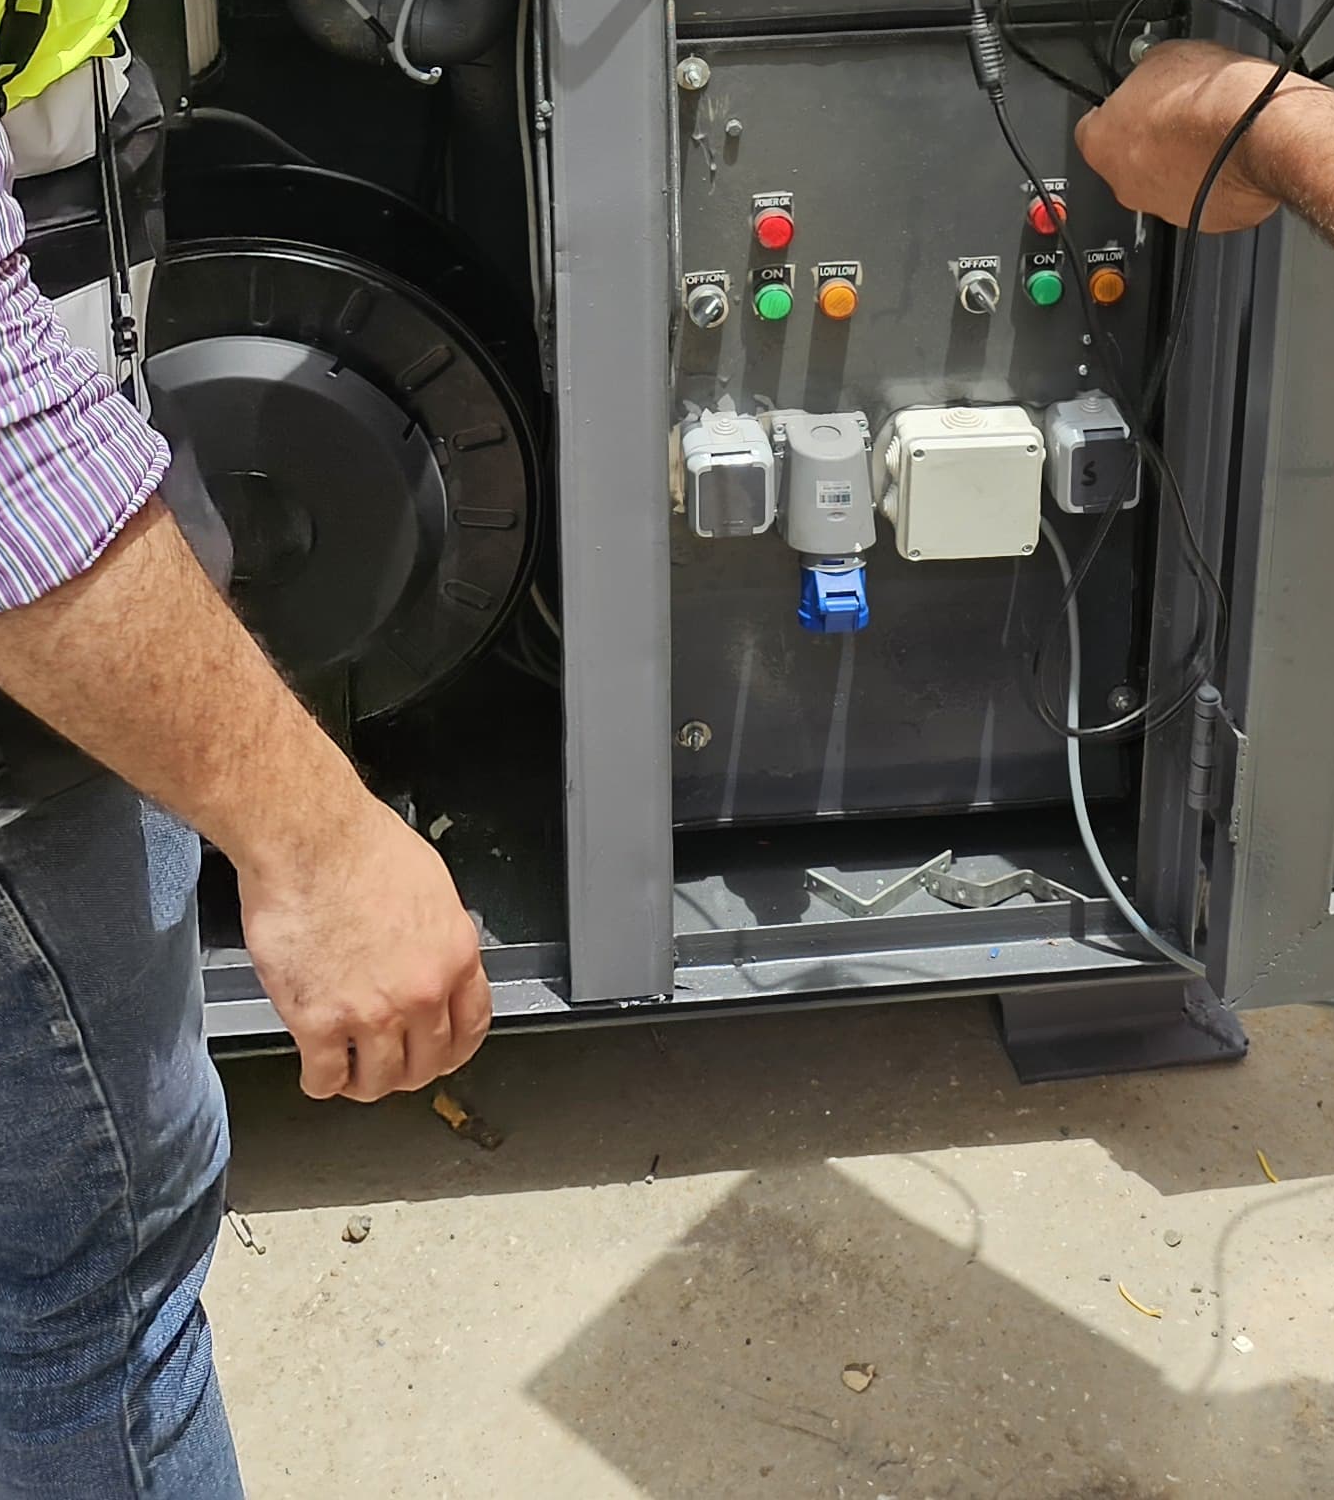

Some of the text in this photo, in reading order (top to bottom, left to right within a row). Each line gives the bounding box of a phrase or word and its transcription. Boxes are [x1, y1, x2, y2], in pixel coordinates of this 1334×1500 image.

[755, 197, 790, 208] POWER OK
[1033, 254, 1056, 265] ON
[1087, 251, 1123, 262] LOW LOW
[959, 259, 998, 269] OFF/ON
[761, 267, 784, 279] ON
[819, 266, 856, 277] LOW LOW
[686, 274, 725, 285] OFF/ON
